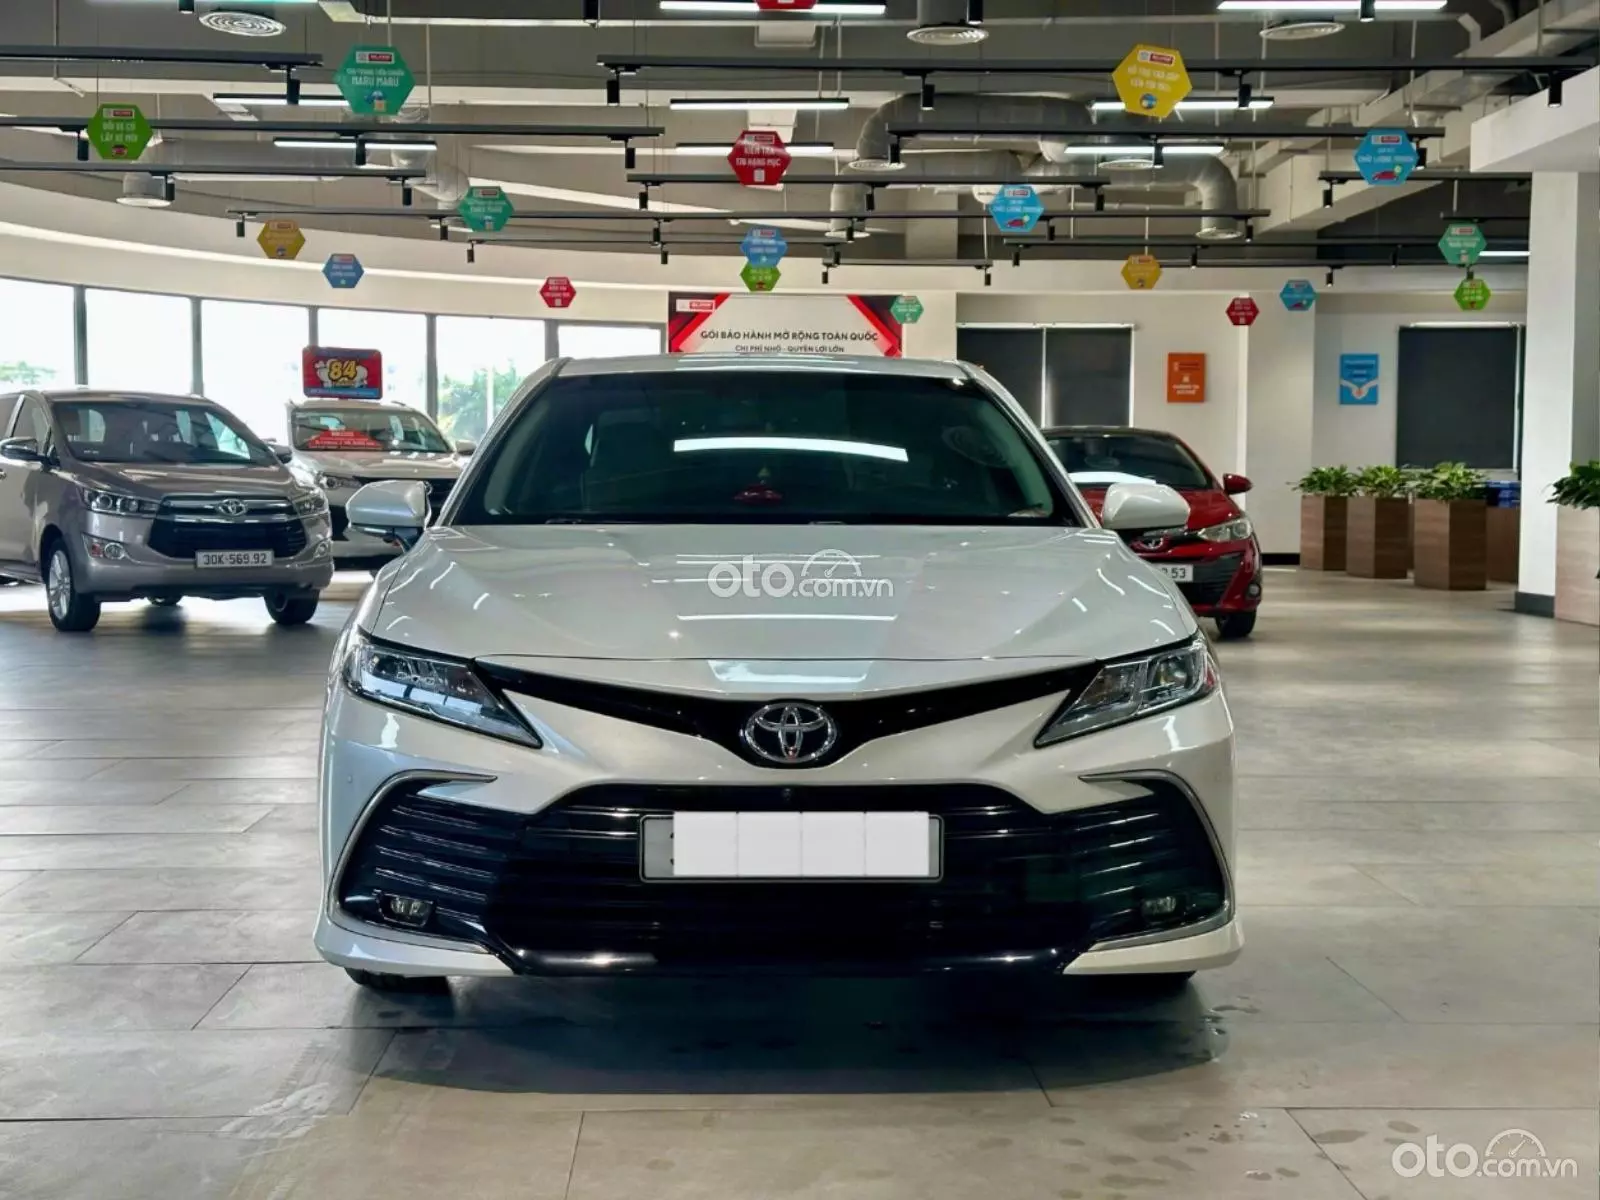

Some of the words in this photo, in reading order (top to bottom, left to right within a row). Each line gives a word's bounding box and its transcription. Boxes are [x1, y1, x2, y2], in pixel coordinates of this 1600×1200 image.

[743, 329, 772, 340] HÀNH
[792, 329, 820, 342] RỘNG
[822, 330, 848, 341] TOÀN
[850, 330, 879, 341] QUỐC
